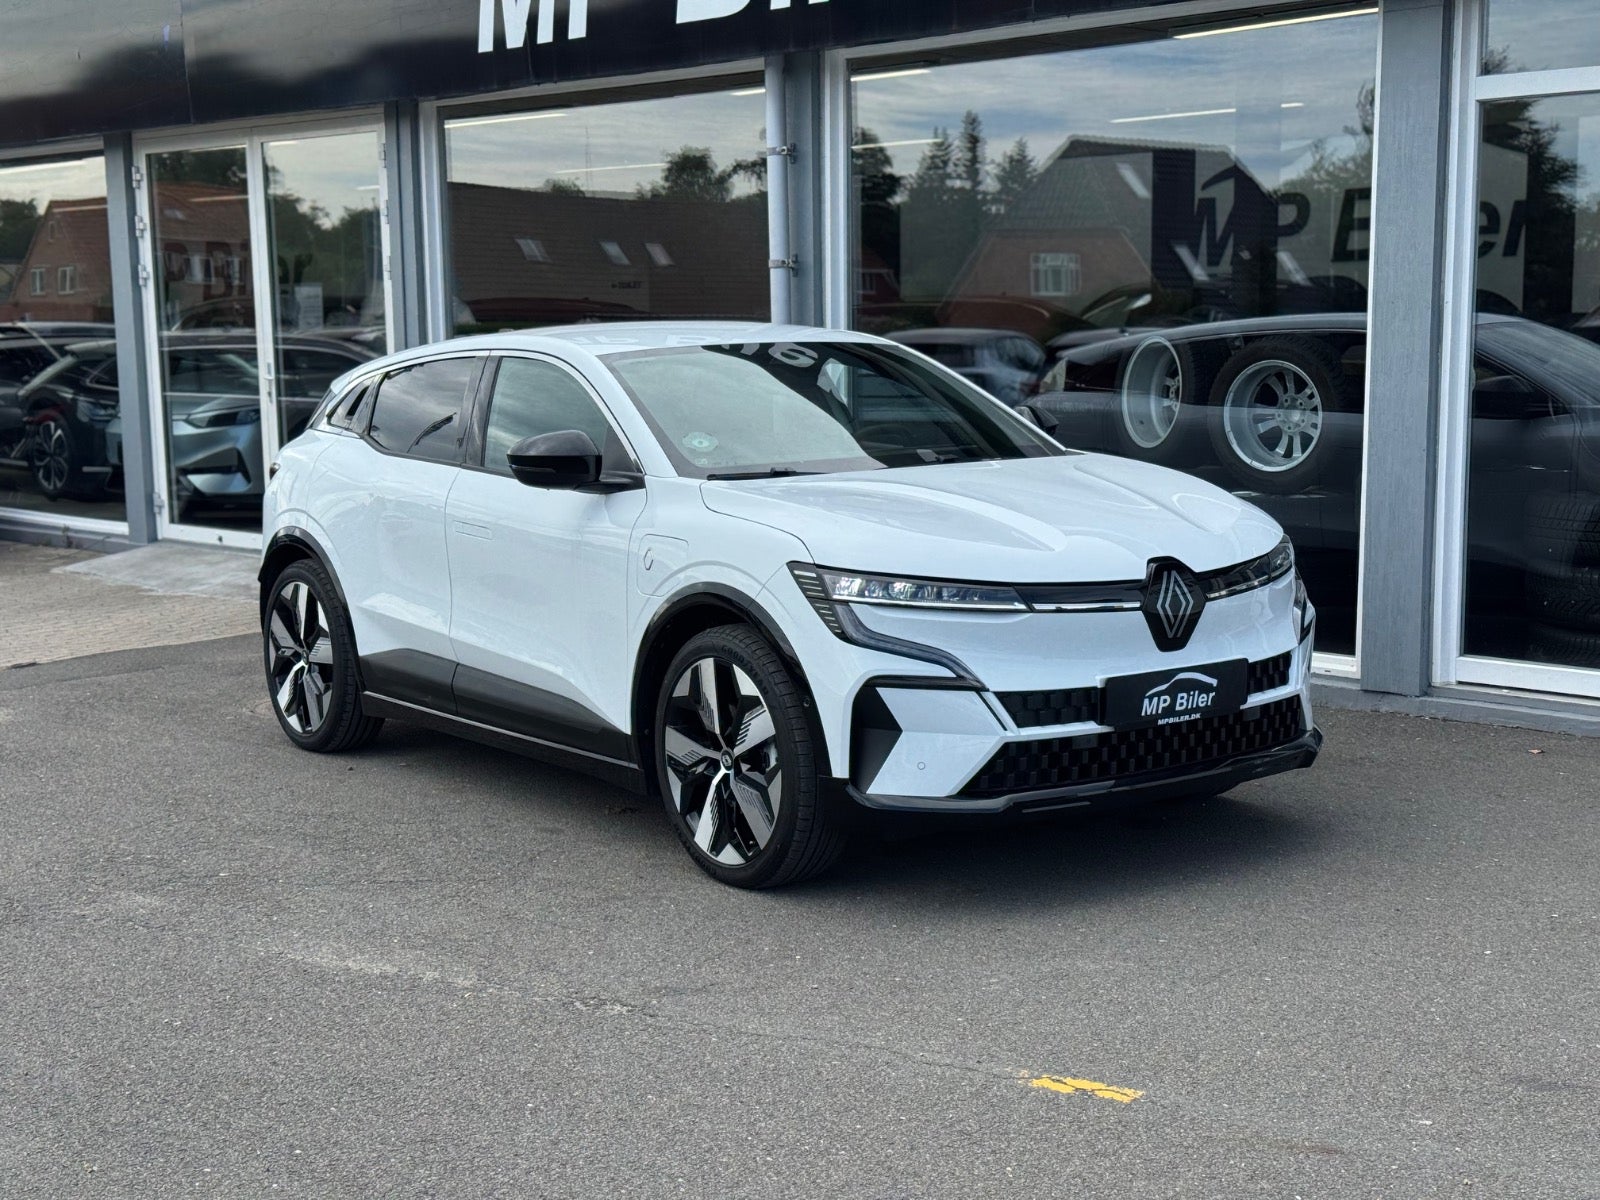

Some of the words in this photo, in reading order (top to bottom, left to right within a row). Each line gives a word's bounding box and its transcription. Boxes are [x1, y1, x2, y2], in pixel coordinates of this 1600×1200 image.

[1141, 695, 1171, 716] MP
[1175, 690, 1216, 711] Biler
[1157, 713, 1202, 725] MPBILER.DK
